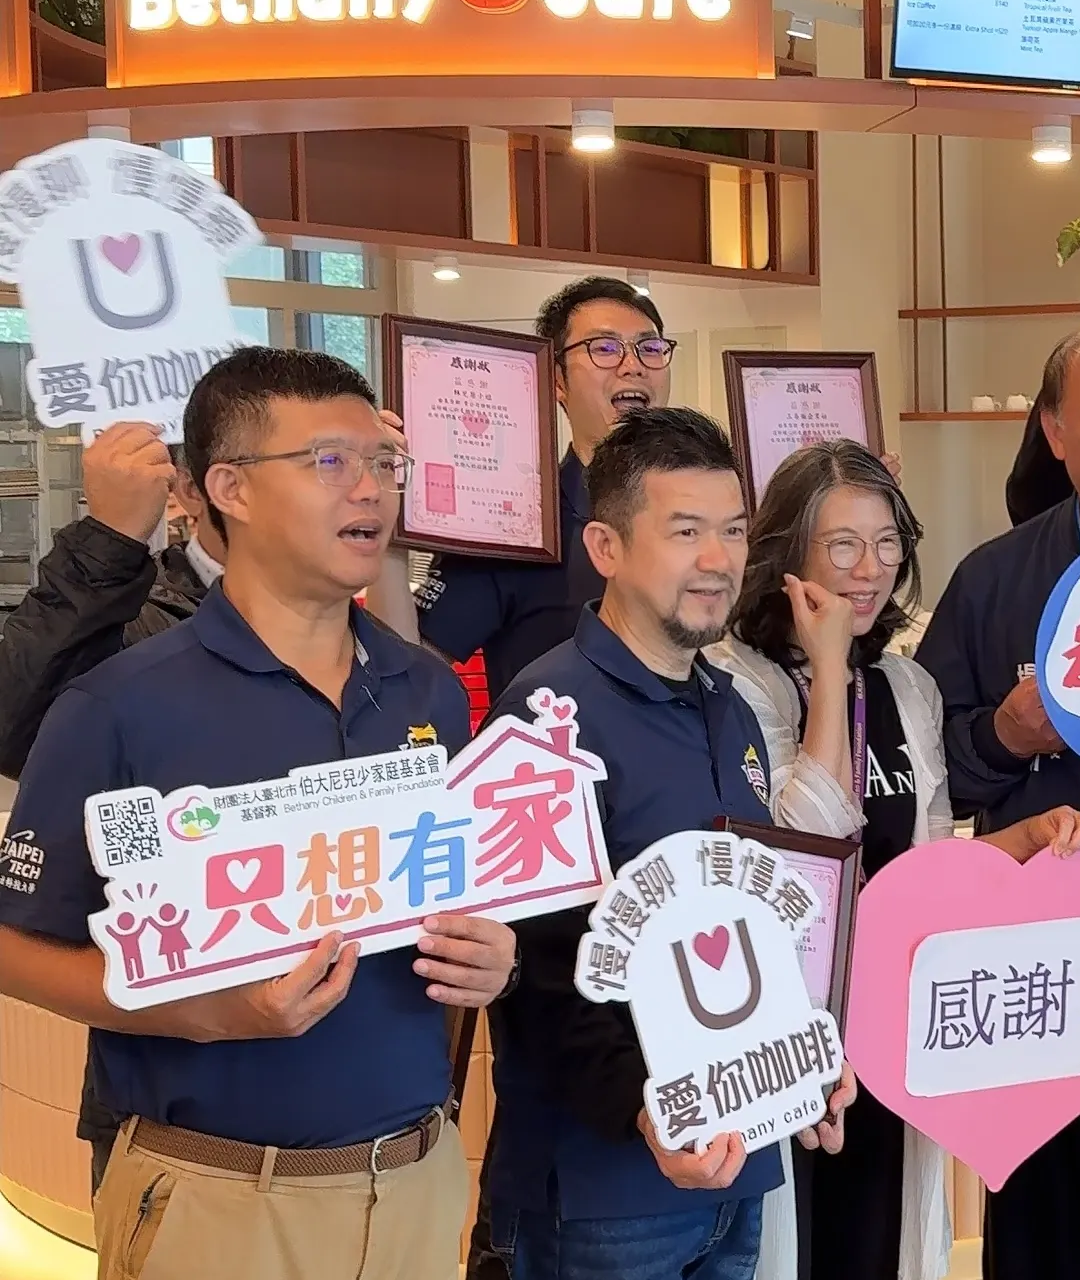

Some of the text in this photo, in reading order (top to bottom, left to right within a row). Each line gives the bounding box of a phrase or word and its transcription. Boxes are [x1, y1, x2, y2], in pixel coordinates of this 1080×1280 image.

[450, 356, 491, 373] 感謝狀
[786, 382, 822, 394] 感謝狀
[213, 753, 440, 810] 財團法人臺北市 伯大尼兒少家庭基金會
[240, 776, 445, 822] 基督教 Bethany Children & Family Foundation
[0, 838, 46, 864] TAIPEI
[200, 761, 576, 952] 只想有家
[9, 859, 42, 880] TECH
[656, 1018, 836, 1139] 愛你咖啡
[784, 1099, 819, 1125] cafe
